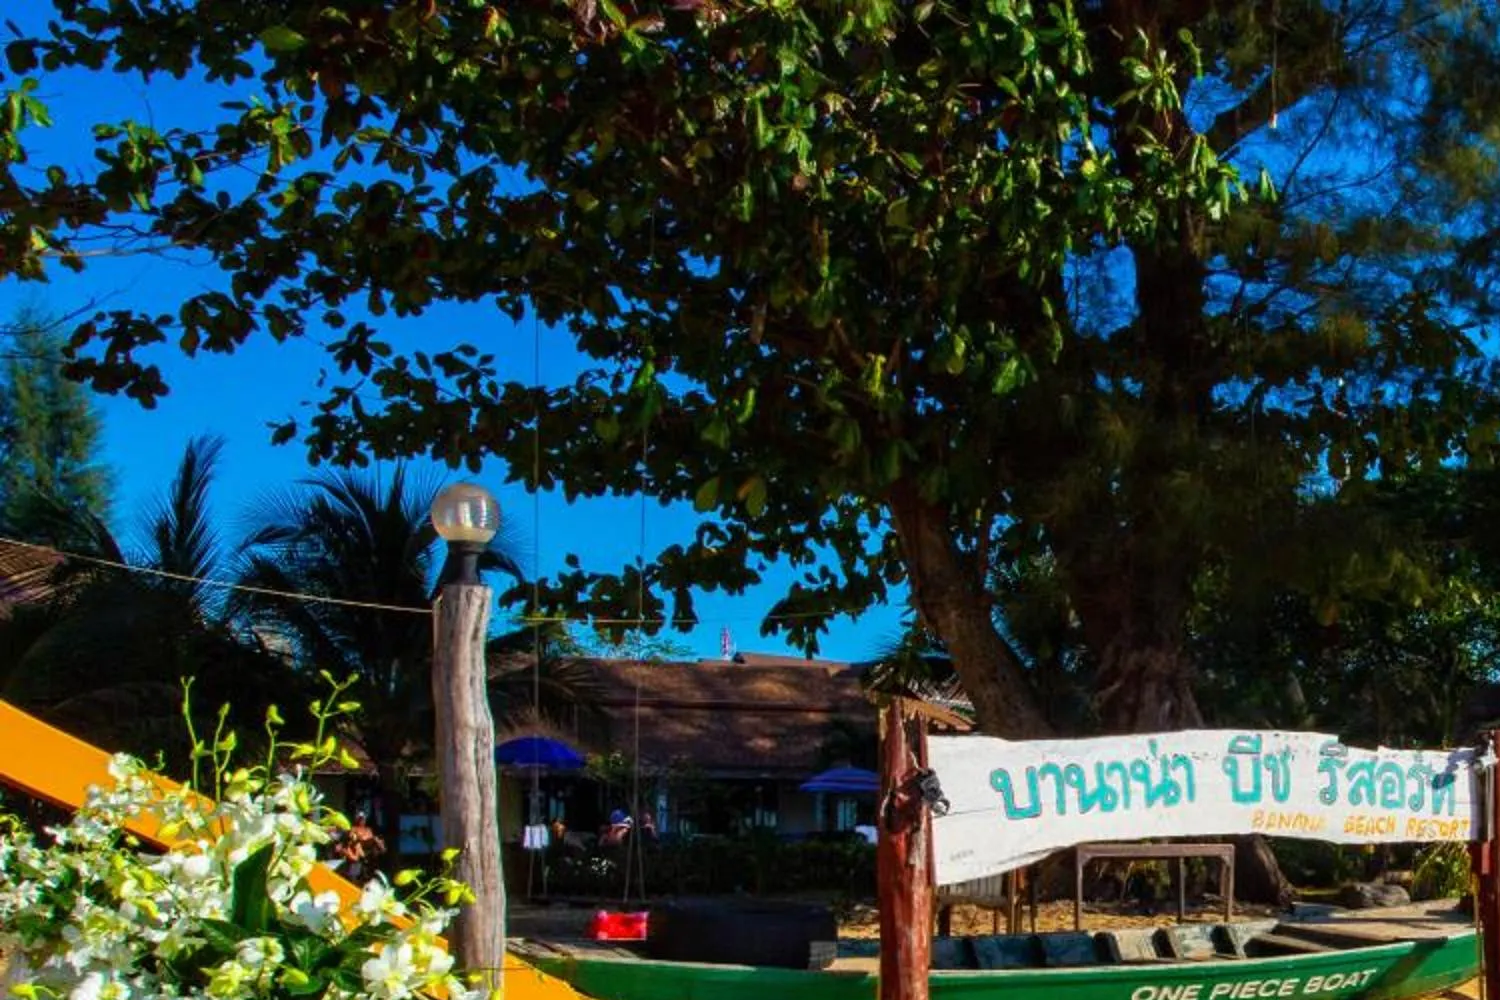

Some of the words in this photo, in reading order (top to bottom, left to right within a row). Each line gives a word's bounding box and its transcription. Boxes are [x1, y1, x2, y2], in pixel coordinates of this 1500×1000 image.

[989, 738, 1195, 820] บานาน่า
[1222, 735, 1291, 804] บีช
[1343, 815, 1397, 836] BEACH
[1406, 816, 1470, 838] RESORT
[1209, 977, 1300, 1000] PIECE
[1303, 968, 1377, 994] BOAT
